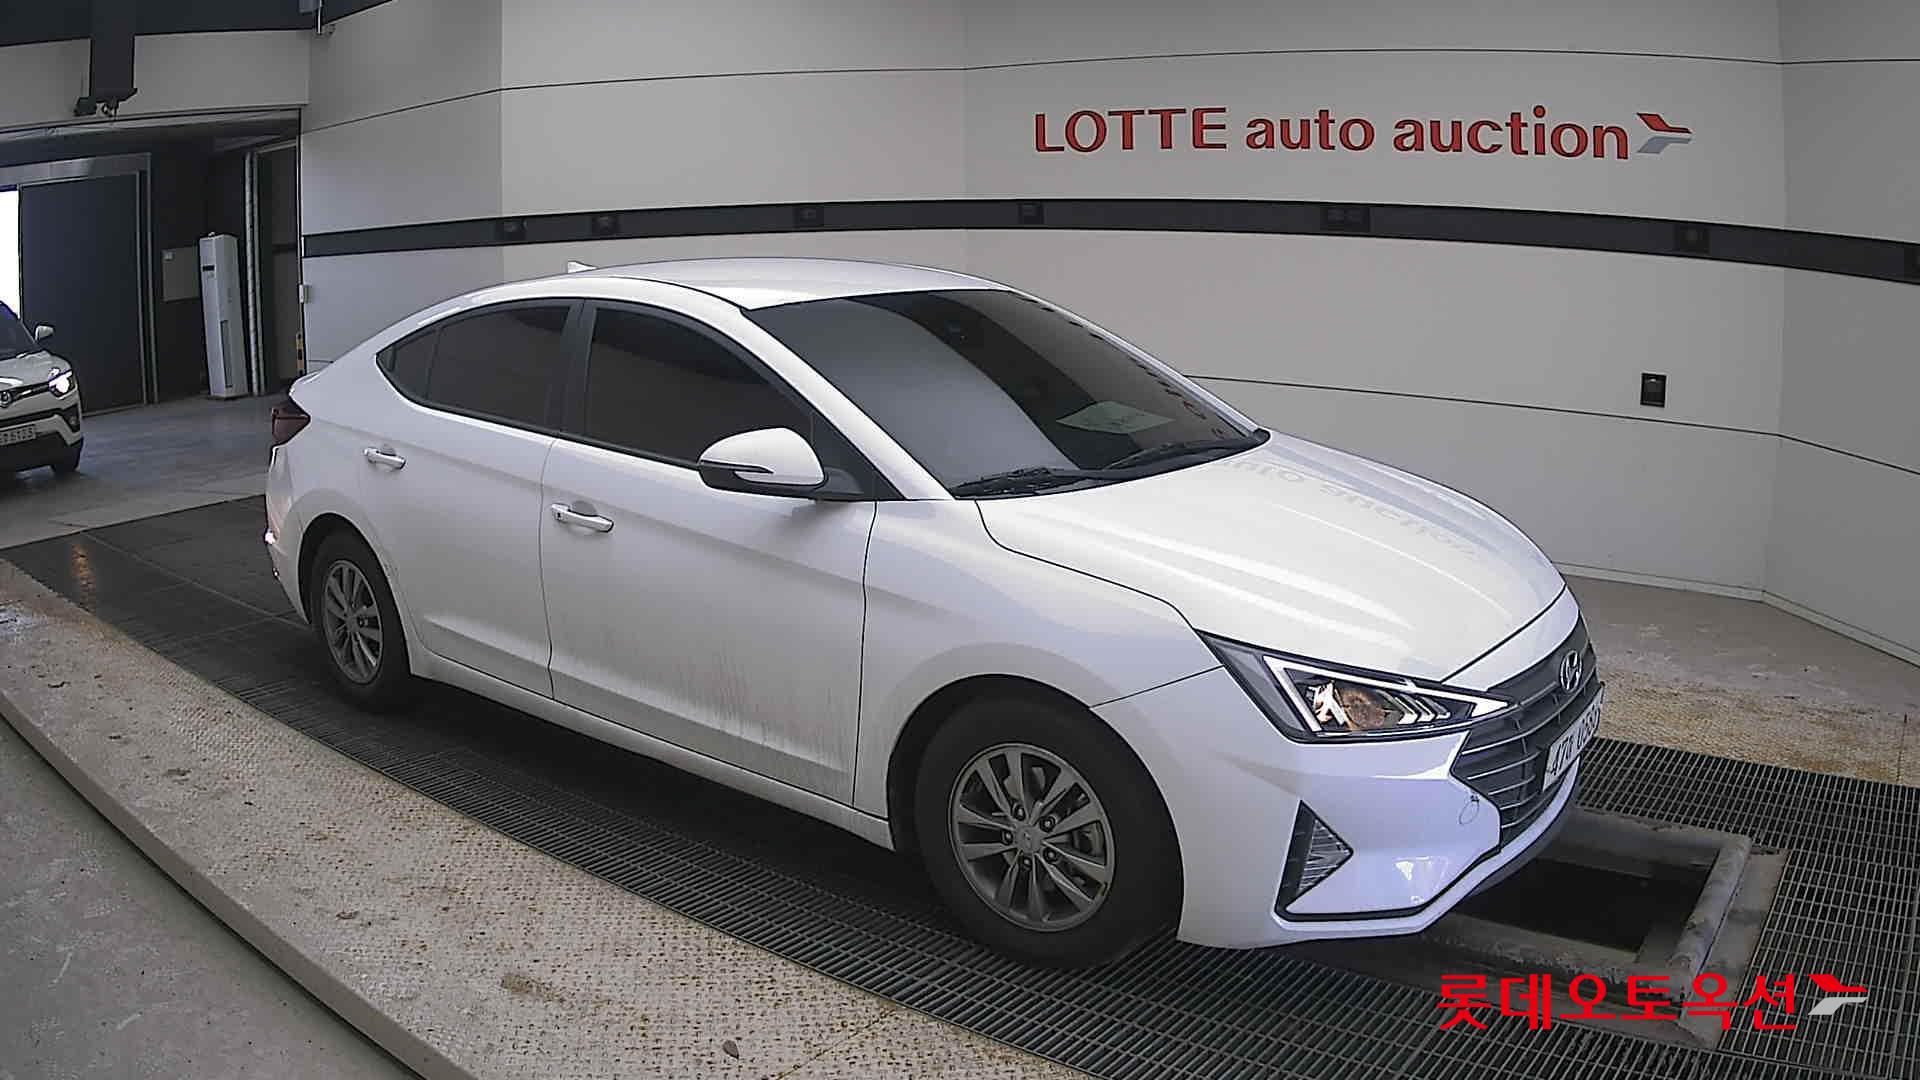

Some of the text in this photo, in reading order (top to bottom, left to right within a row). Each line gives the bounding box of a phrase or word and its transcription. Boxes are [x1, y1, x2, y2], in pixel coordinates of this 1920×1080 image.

[1034, 106, 1629, 160] LOTTE auto auction
